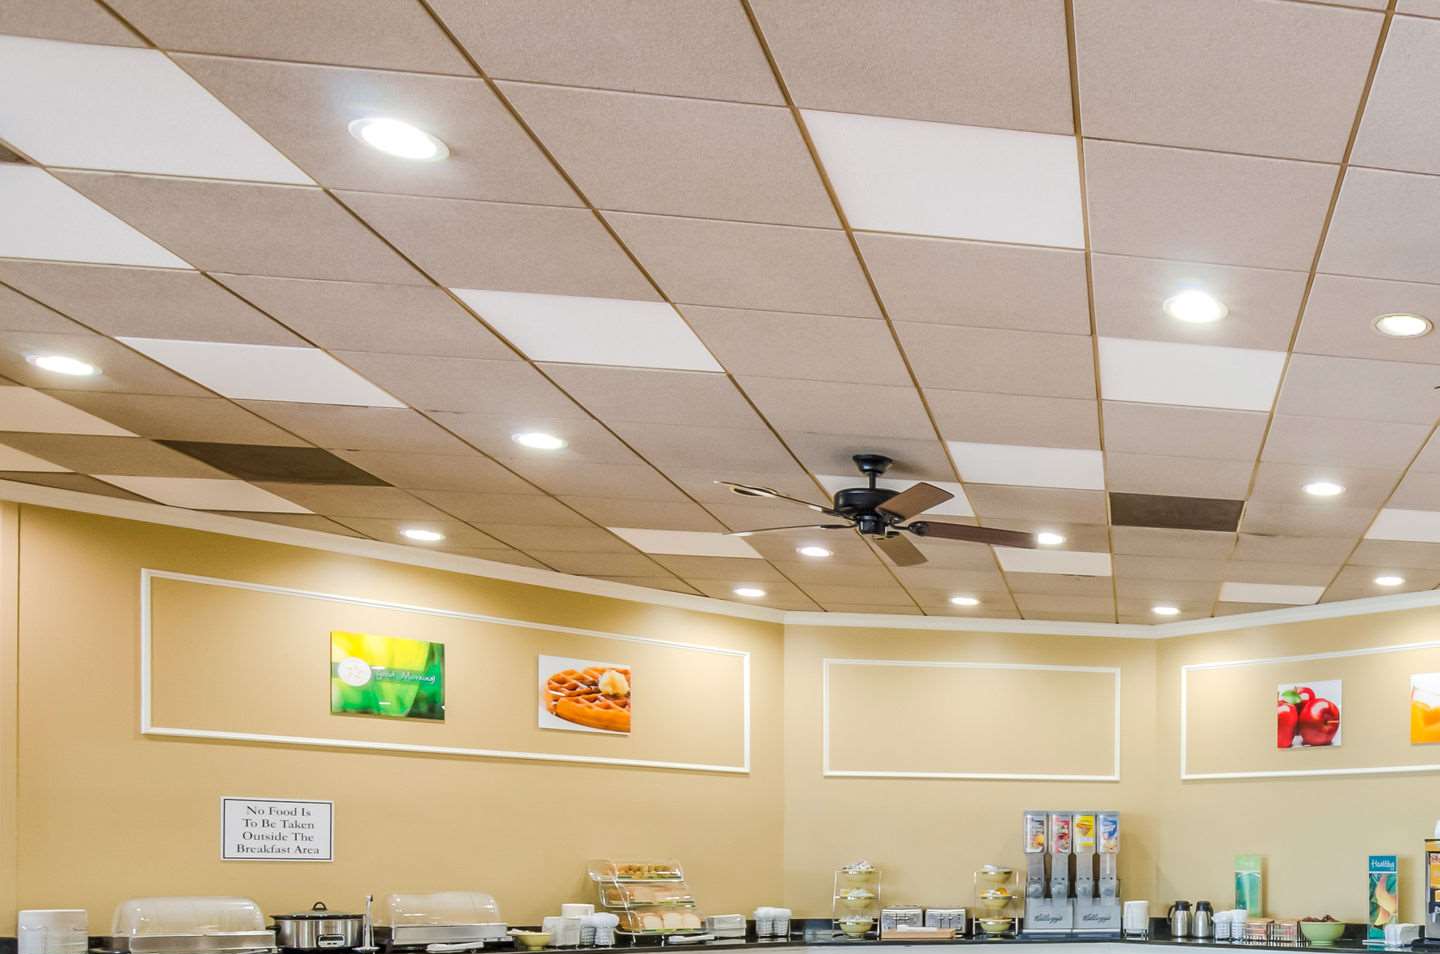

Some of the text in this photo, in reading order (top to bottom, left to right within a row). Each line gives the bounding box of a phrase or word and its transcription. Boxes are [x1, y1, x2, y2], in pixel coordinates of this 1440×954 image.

[247, 805, 312, 817] No Food Is
[241, 818, 315, 830] To Be Taken
[242, 831, 314, 842] Outside The
[237, 843, 320, 855] Breakfast Area
